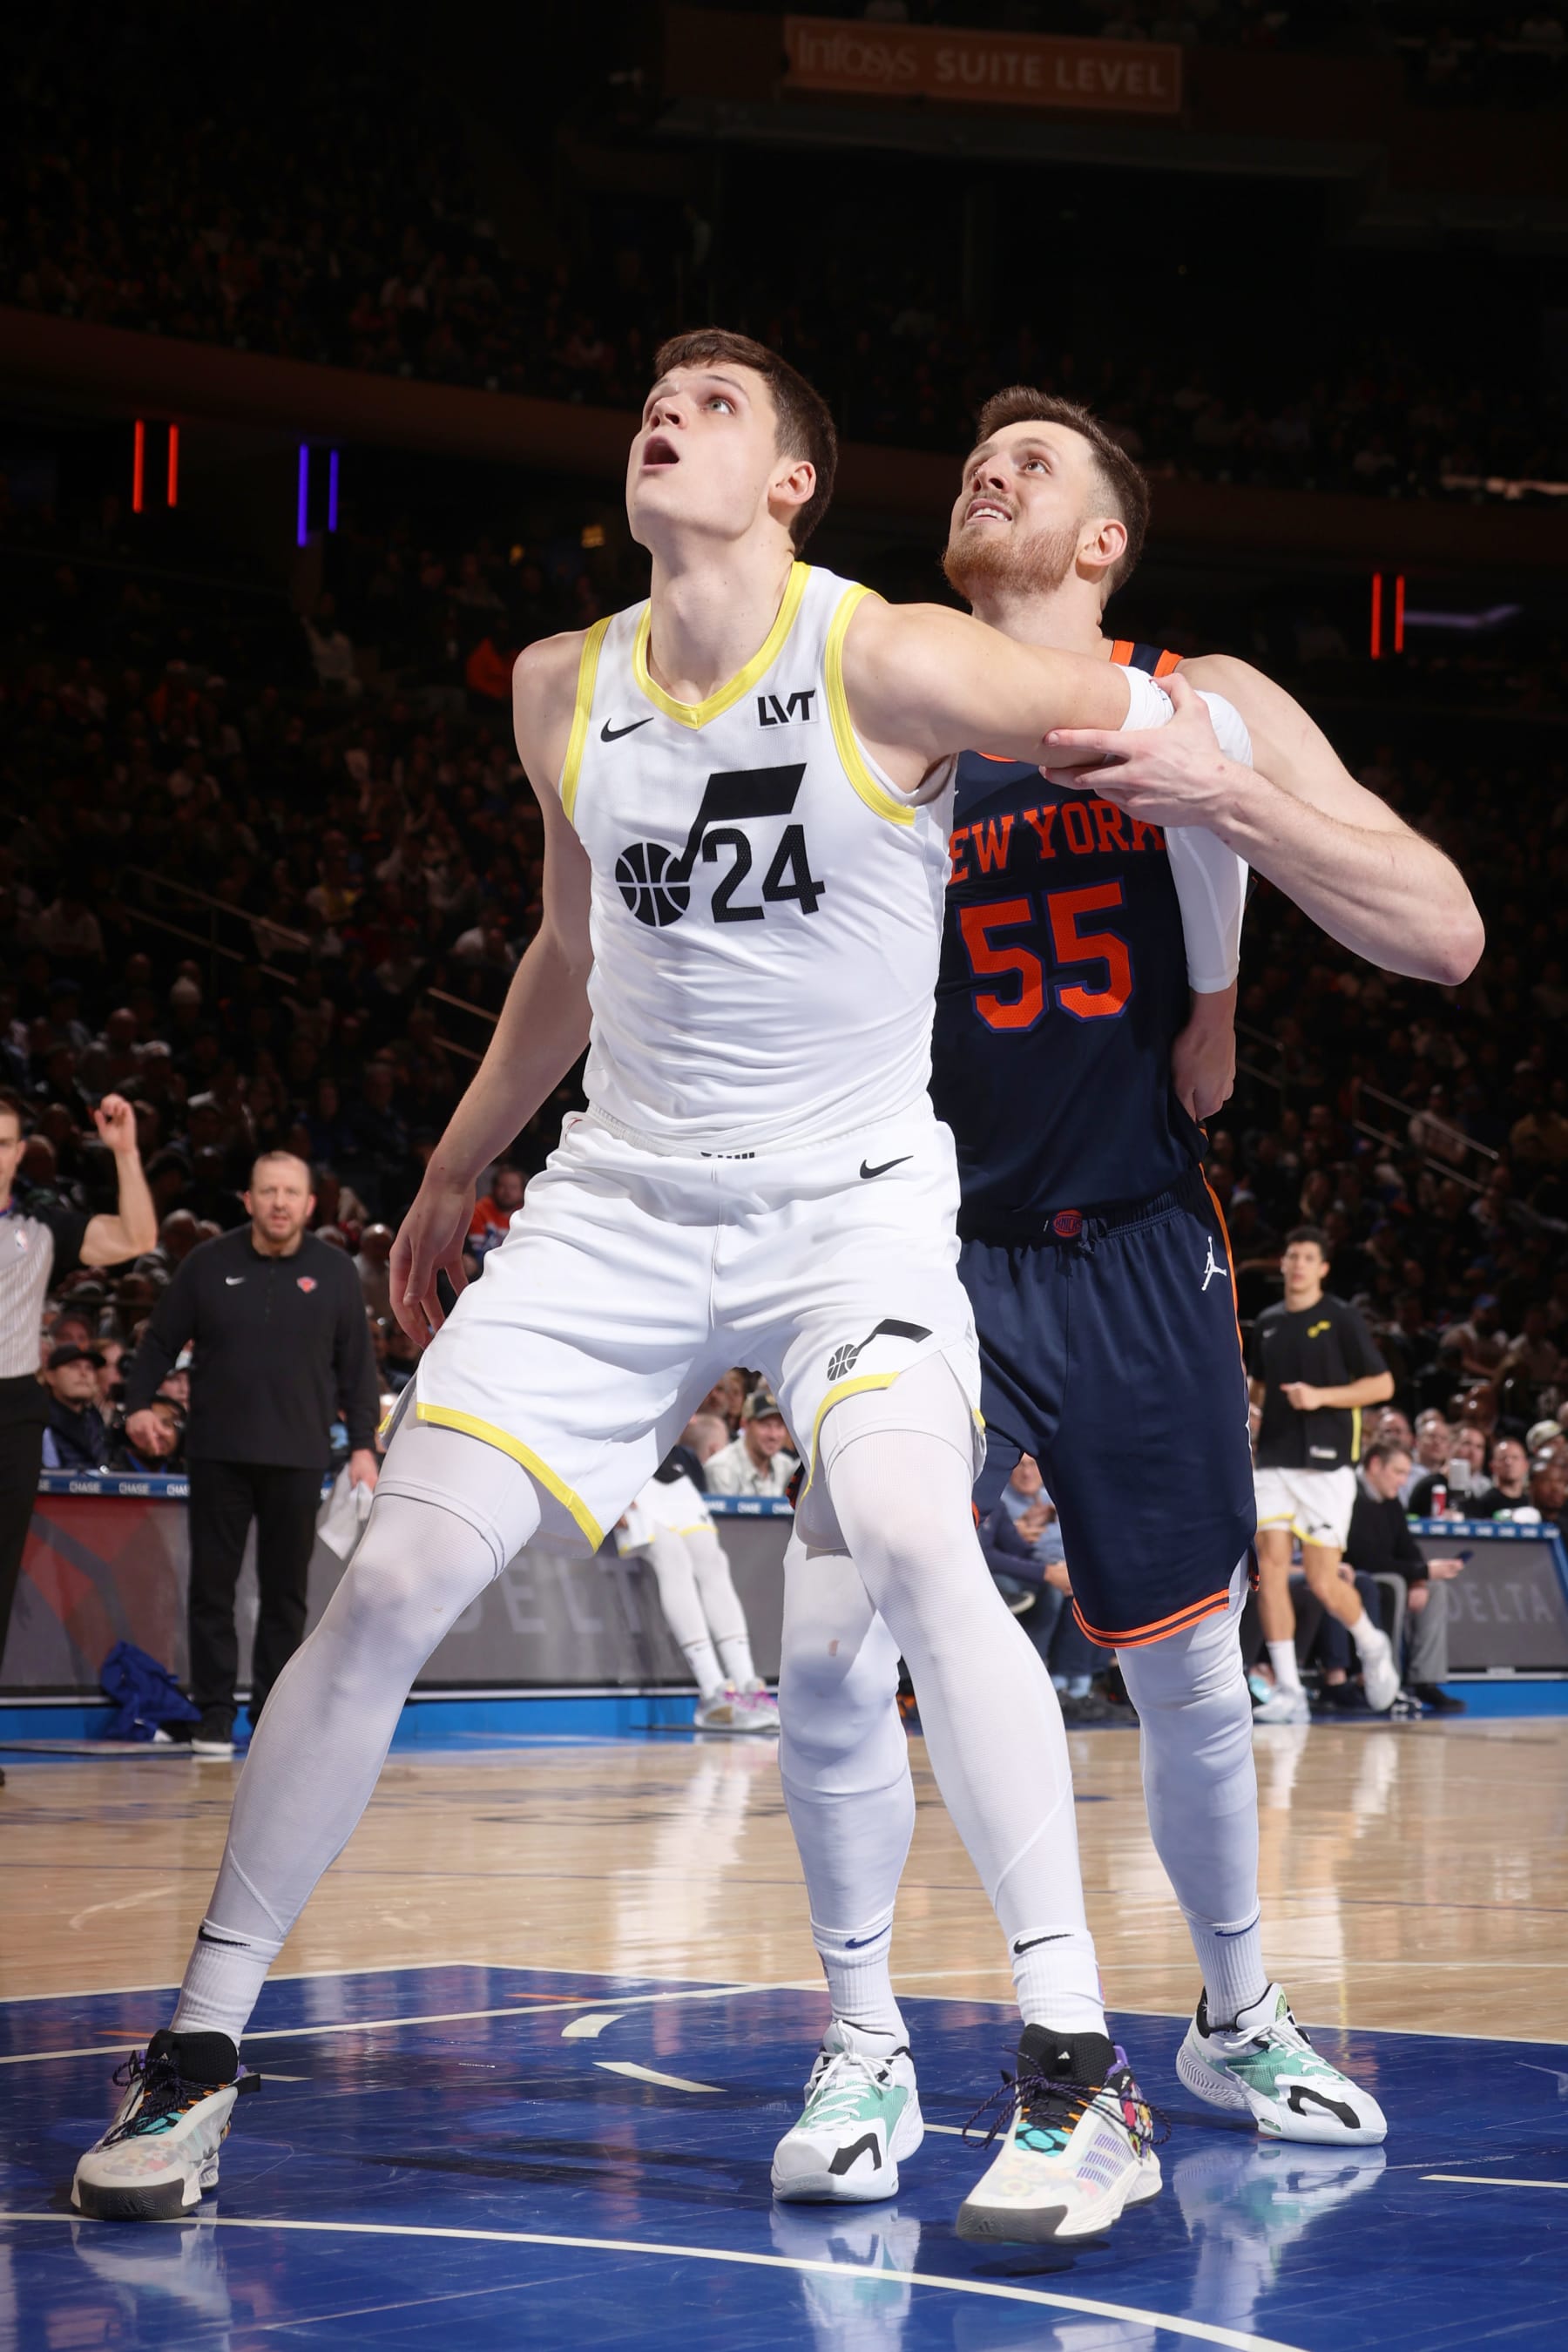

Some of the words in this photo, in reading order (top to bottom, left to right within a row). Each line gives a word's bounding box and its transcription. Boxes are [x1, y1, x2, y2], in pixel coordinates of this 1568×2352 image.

[798, 30, 917, 82] Infosys
[935, 50, 1041, 87] SUITE
[1055, 57, 1166, 95] LEVEL
[757, 687, 816, 727] LVT
[701, 824, 827, 923] 24
[948, 814, 1015, 886] EW
[956, 877, 1134, 1031] 55
[118, 1483, 150, 1495] CHASE
